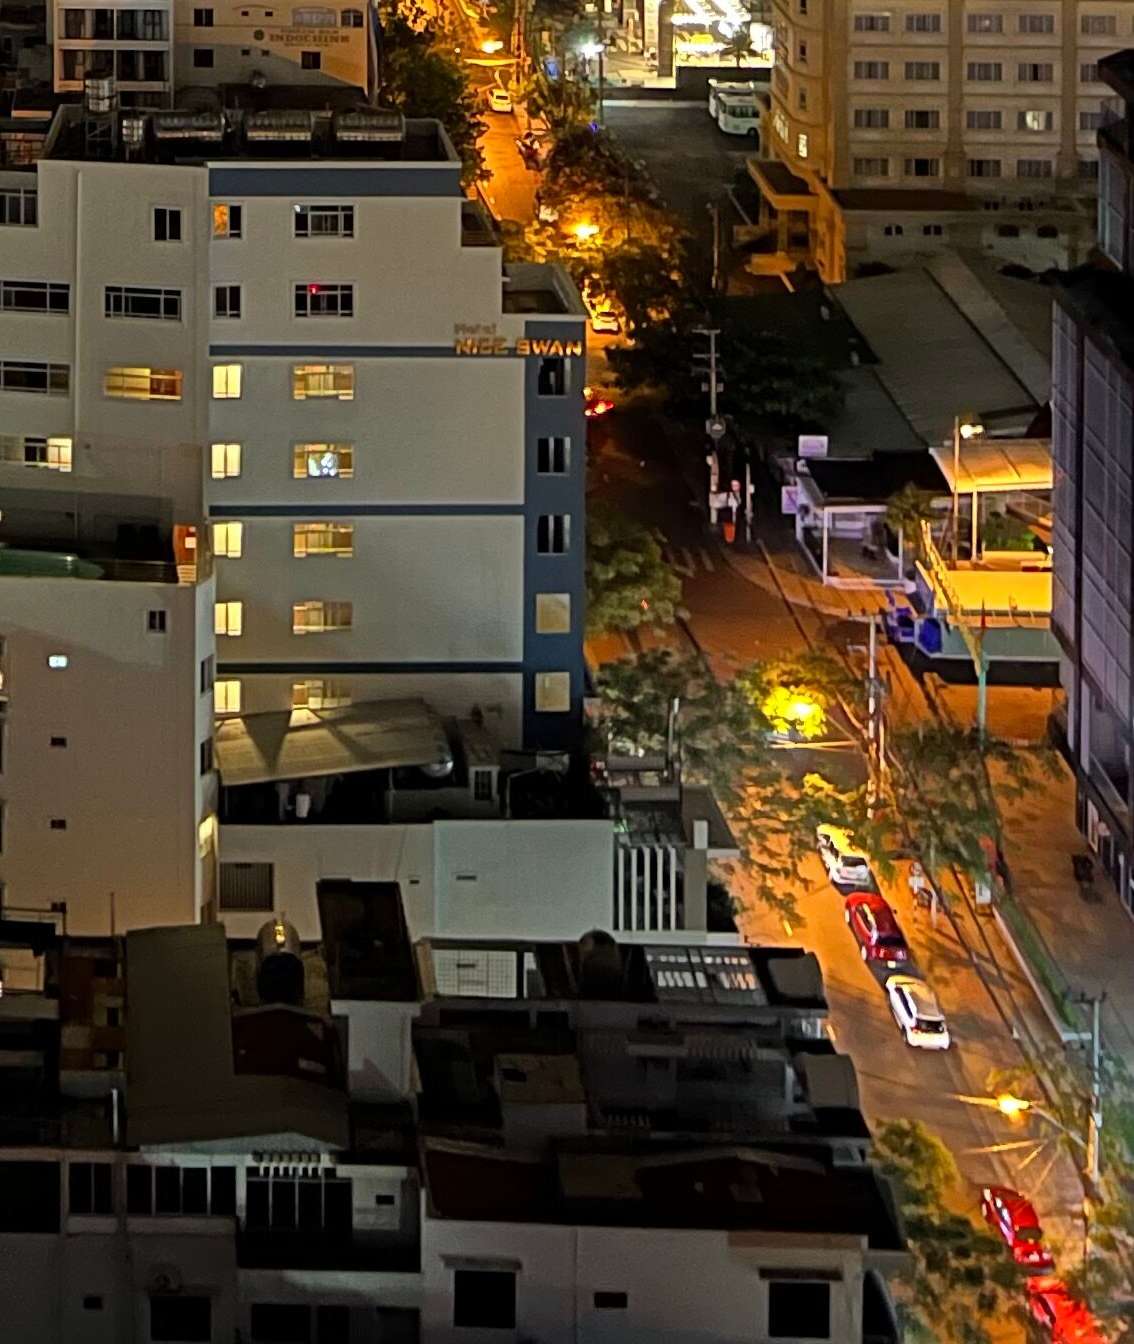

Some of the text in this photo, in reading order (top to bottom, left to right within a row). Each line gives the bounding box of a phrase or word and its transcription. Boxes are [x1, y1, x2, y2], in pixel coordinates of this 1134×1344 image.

[454, 323, 497, 335] Hotel
[455, 337, 583, 357] NICE SWAN
